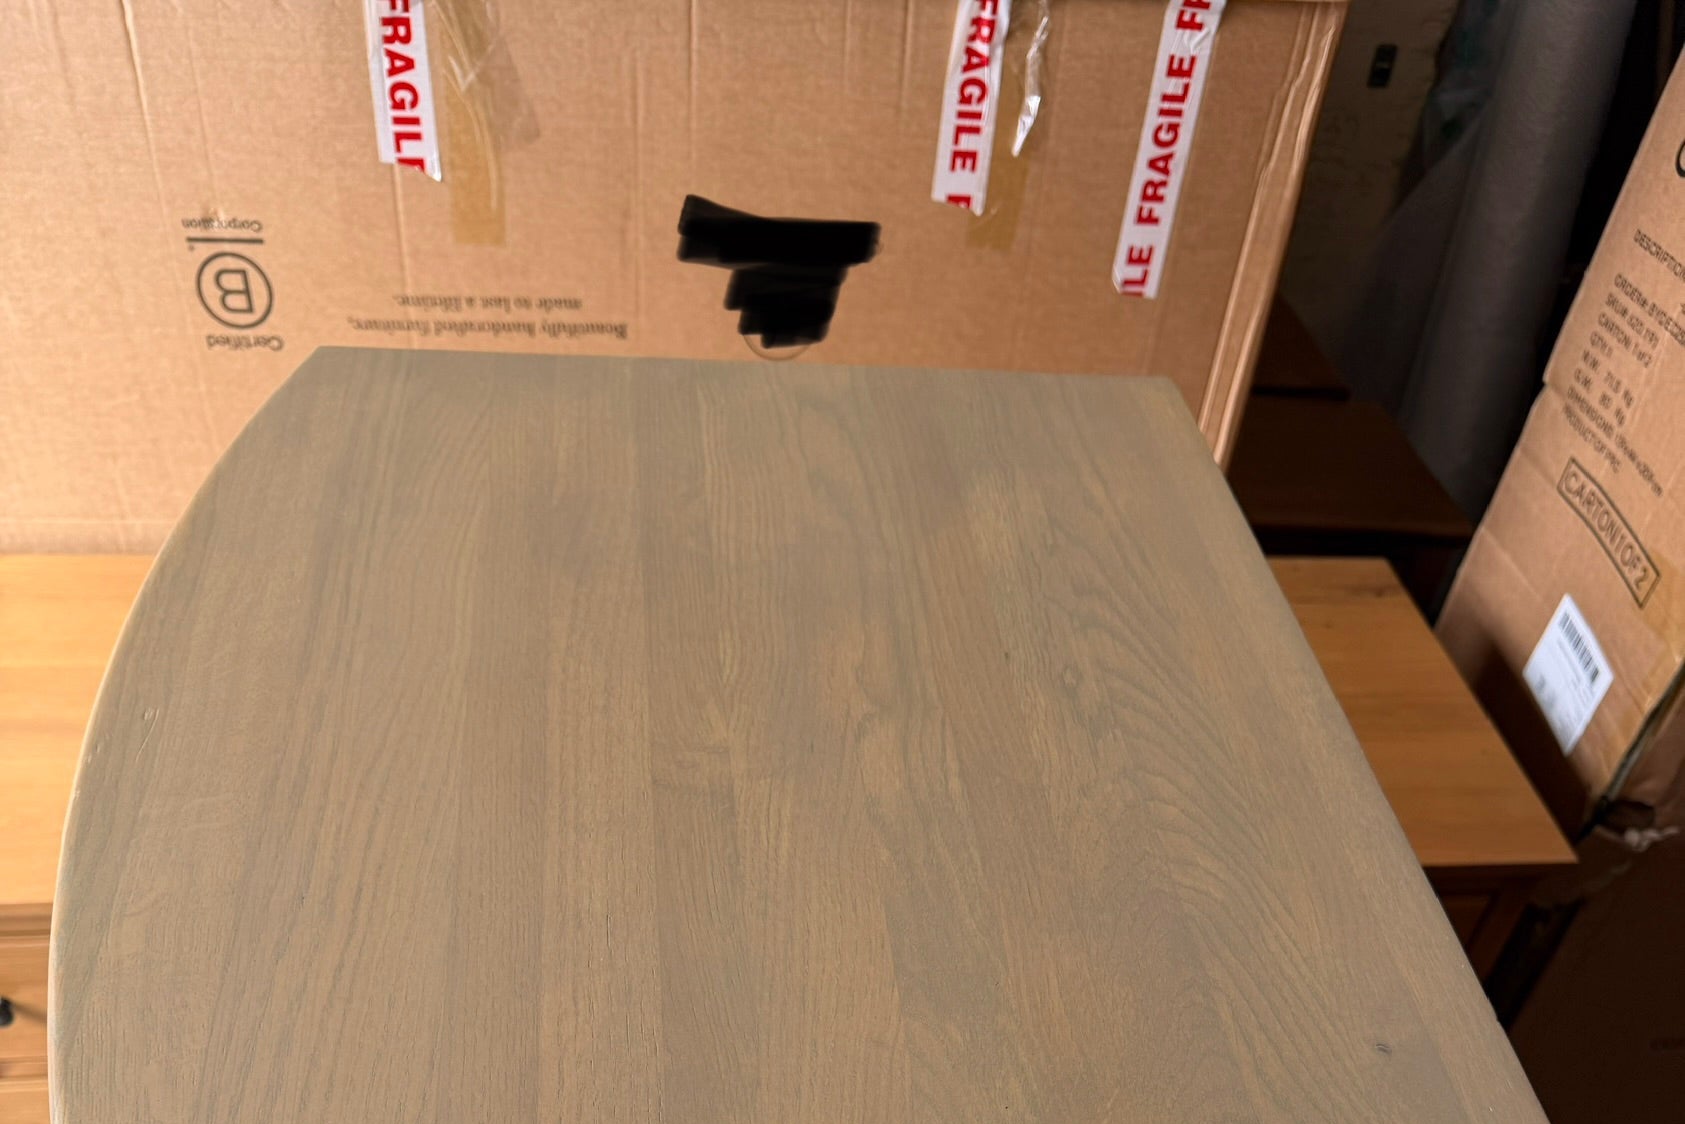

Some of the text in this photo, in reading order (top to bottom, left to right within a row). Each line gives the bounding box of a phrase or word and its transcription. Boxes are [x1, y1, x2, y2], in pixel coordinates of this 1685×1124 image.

[1134, 54, 1197, 226] FRAGILE
[464, 296, 475, 308] a
[480, 296, 511, 315] last
[514, 296, 533, 310] to
[534, 296, 584, 311] made
[434, 317, 536, 338] handcrafted
[541, 318, 629, 340] Beautifully
[205, 335, 285, 352] Certified
[1562, 469, 1624, 548] CARTON
[1619, 540, 1642, 579] OF
[1633, 564, 1649, 592] 2
